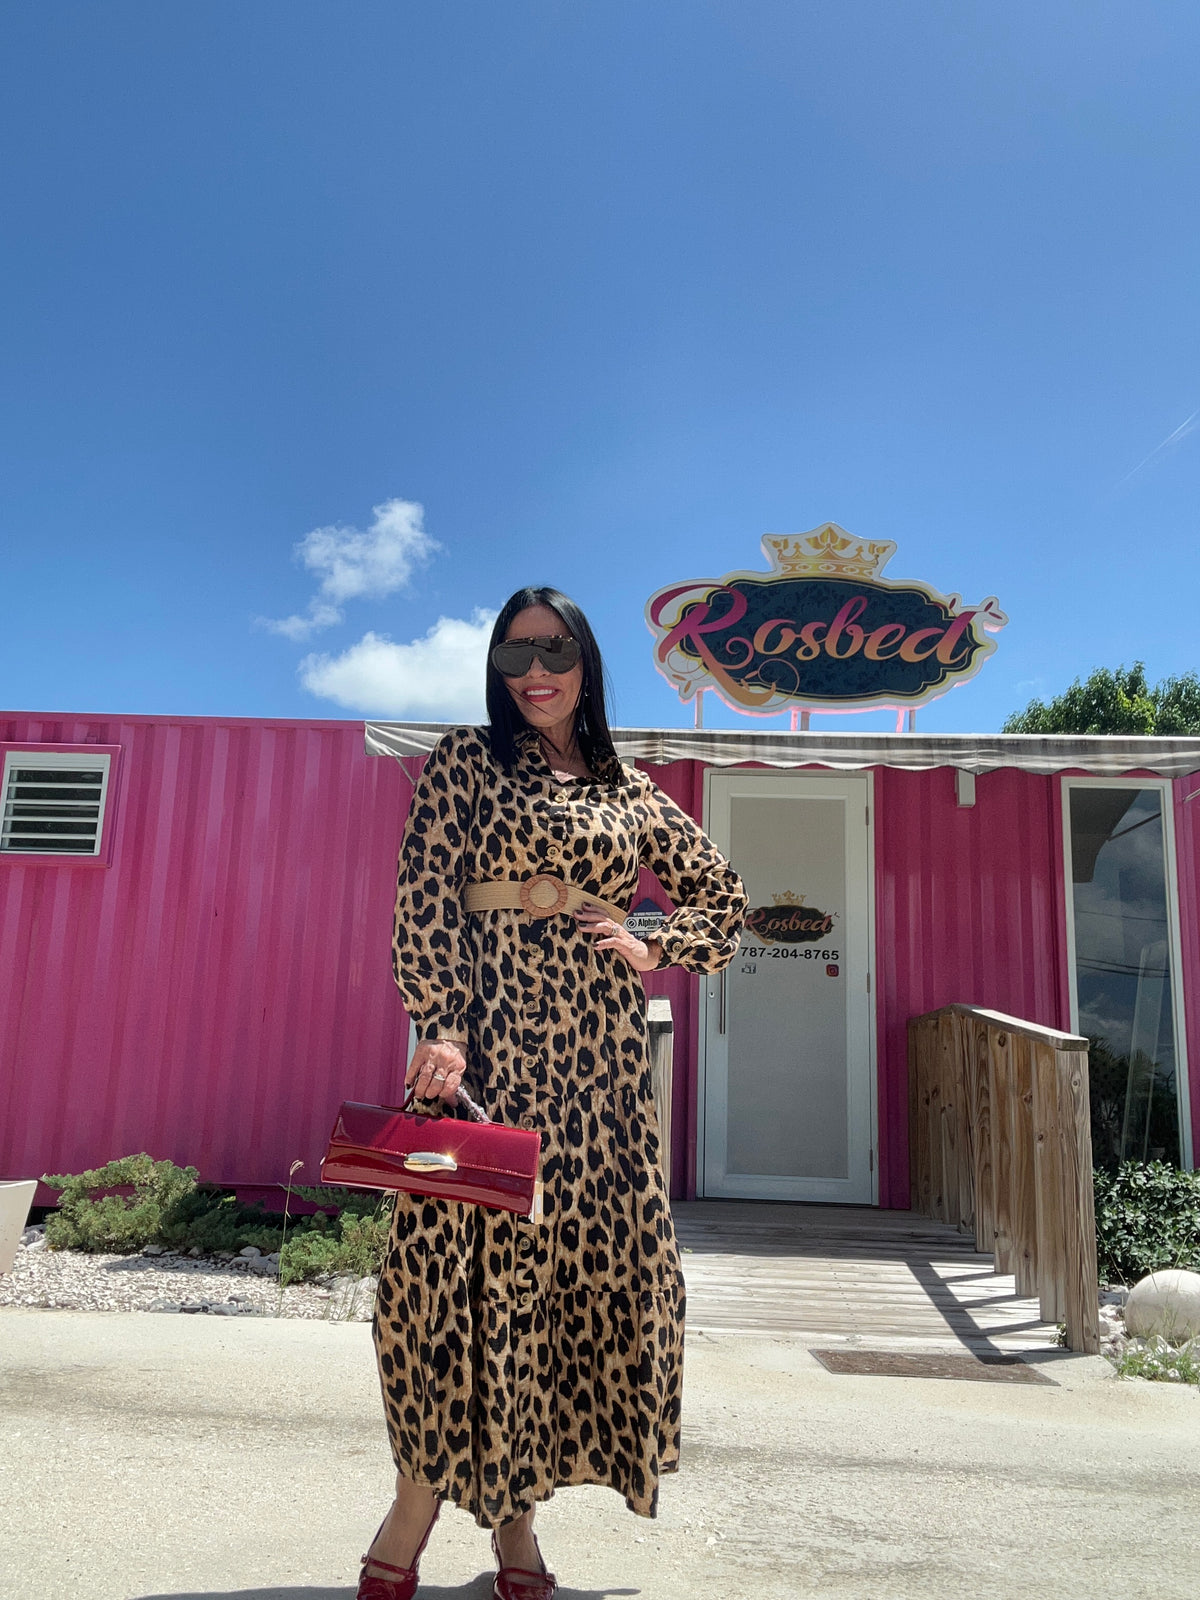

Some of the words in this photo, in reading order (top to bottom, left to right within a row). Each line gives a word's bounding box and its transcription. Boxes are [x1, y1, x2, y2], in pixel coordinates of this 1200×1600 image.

[650, 584, 984, 706] Rosbed
[744, 908, 832, 946] Rosbed
[740, 947, 840, 961] 787-204-8765
